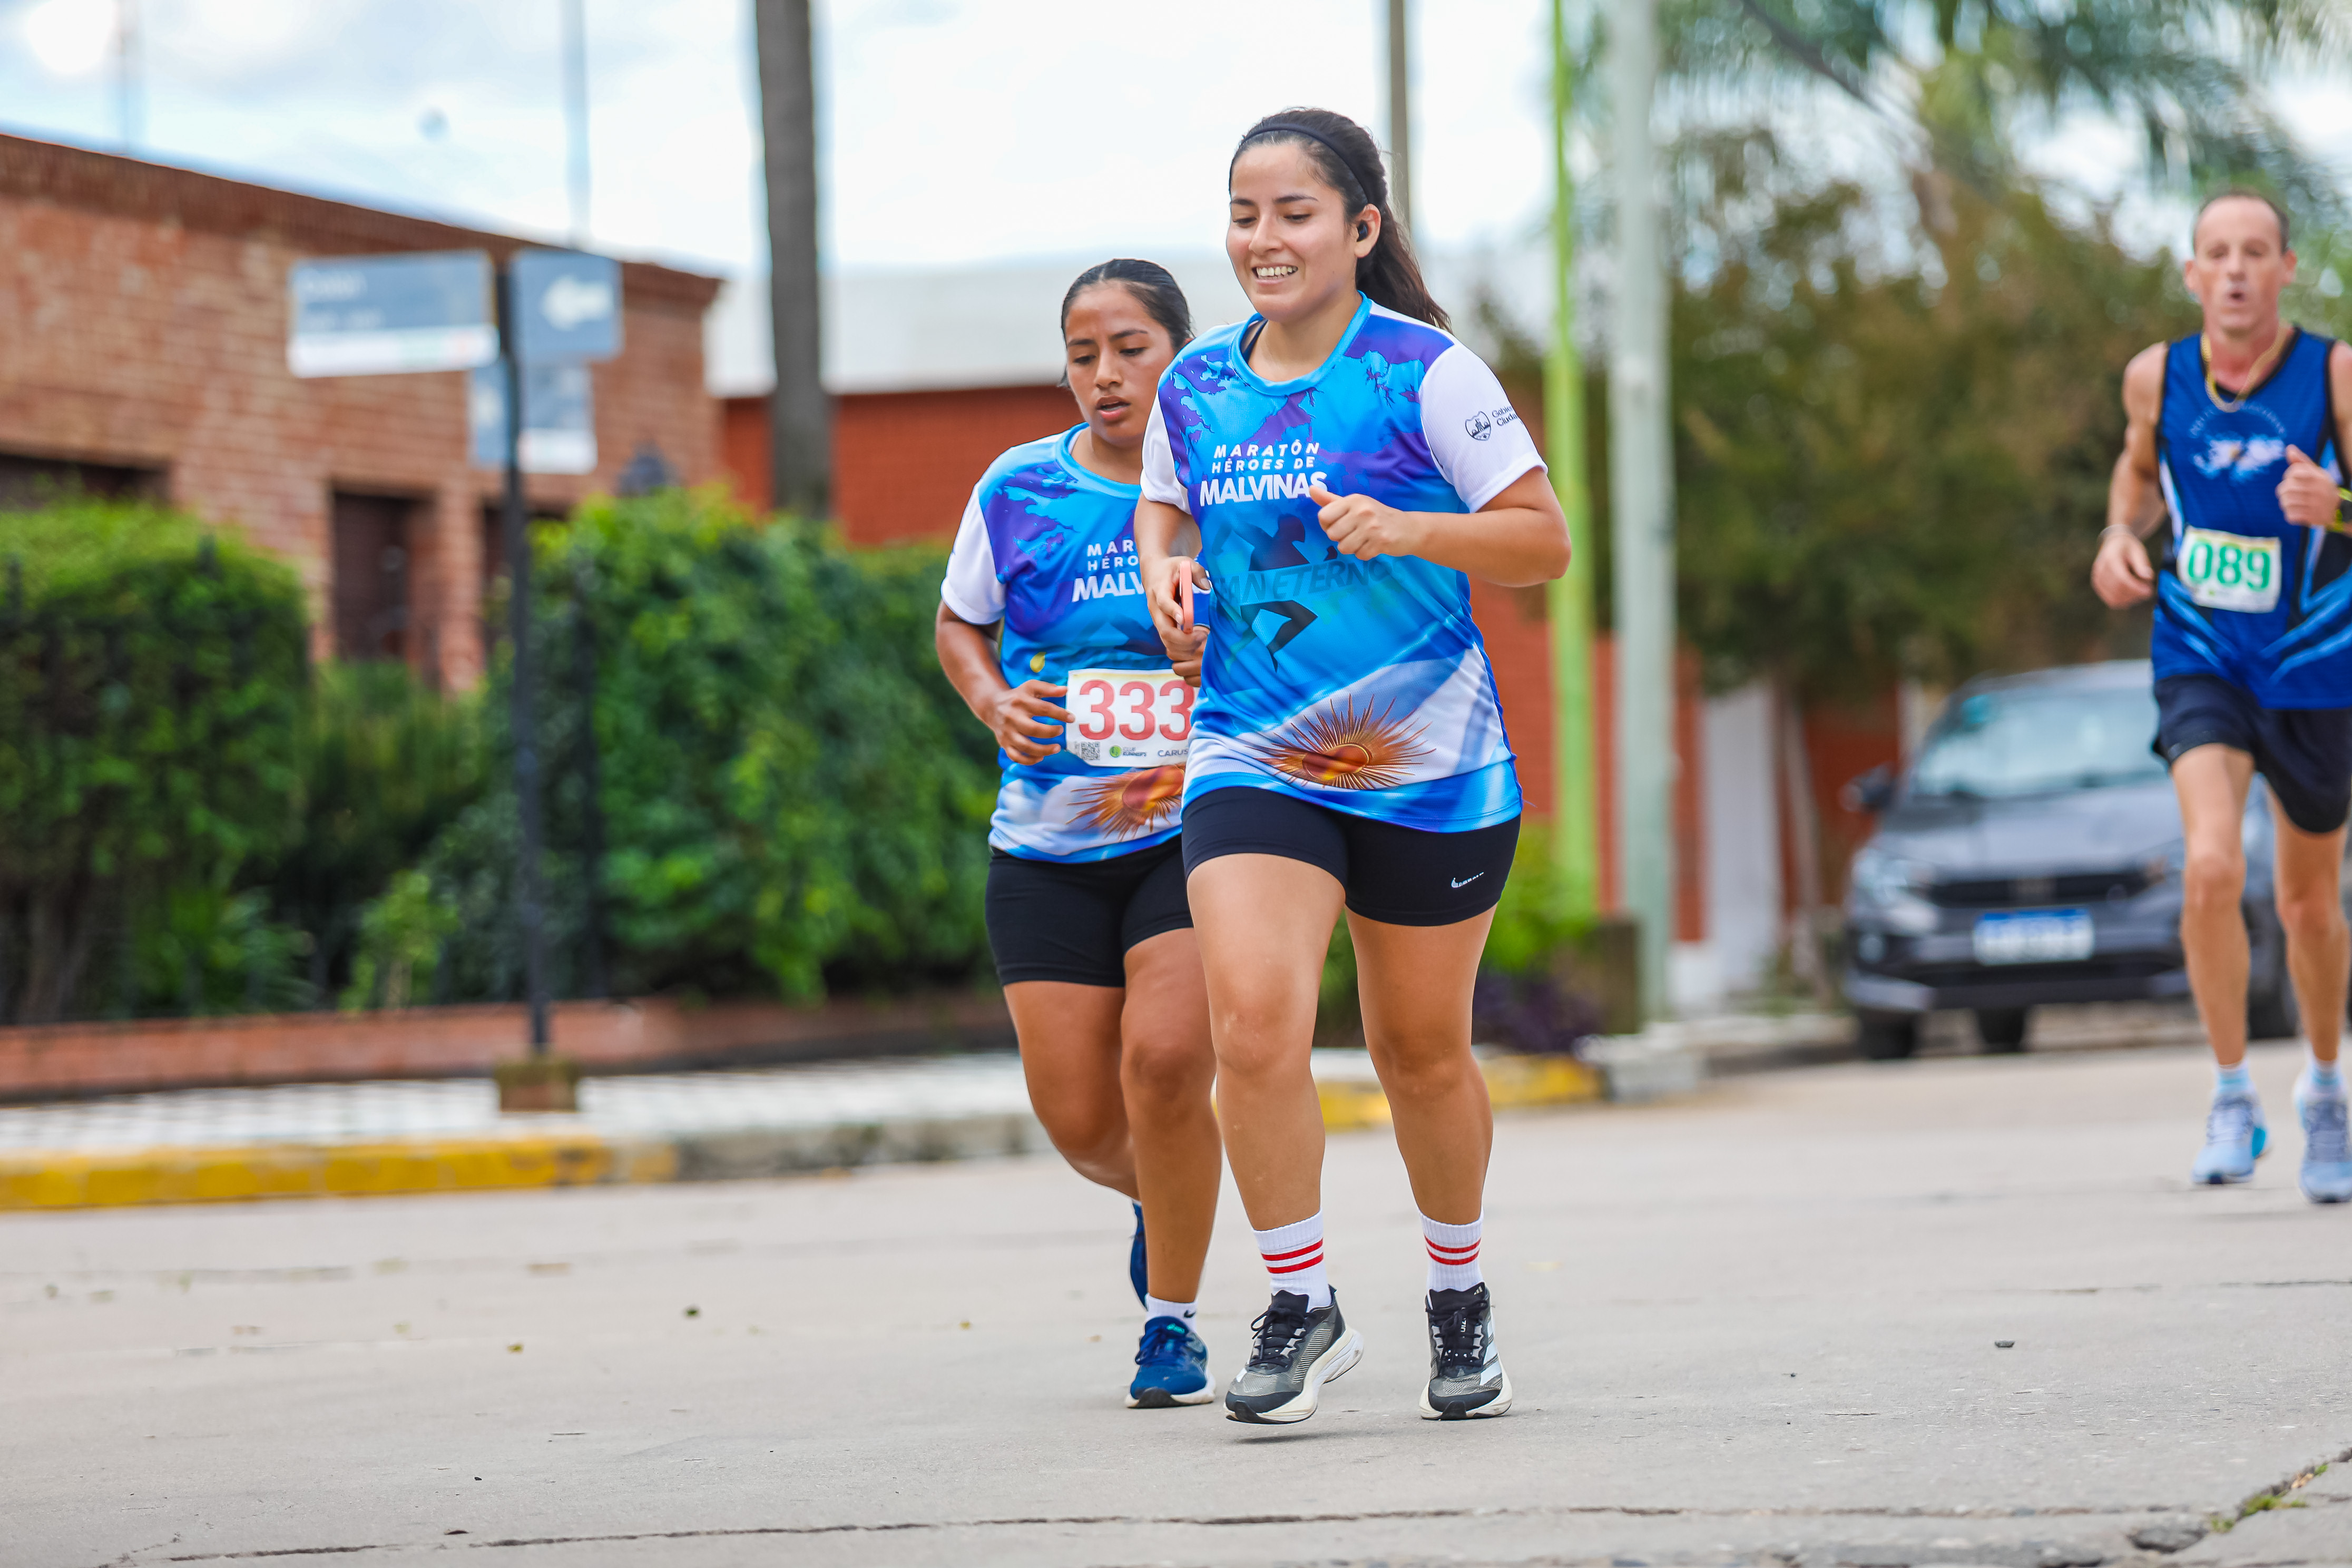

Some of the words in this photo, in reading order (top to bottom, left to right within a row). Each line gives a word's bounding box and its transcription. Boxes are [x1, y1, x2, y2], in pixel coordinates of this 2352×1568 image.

[1211, 458, 1285, 474] HÉROES
[1293, 456, 1315, 469] DE
[1213, 439, 1319, 458] MARATÓN
[1200, 471, 1328, 507] MALVINAS
[2188, 541, 2270, 592] 089
[1079, 679, 1195, 741] 333
